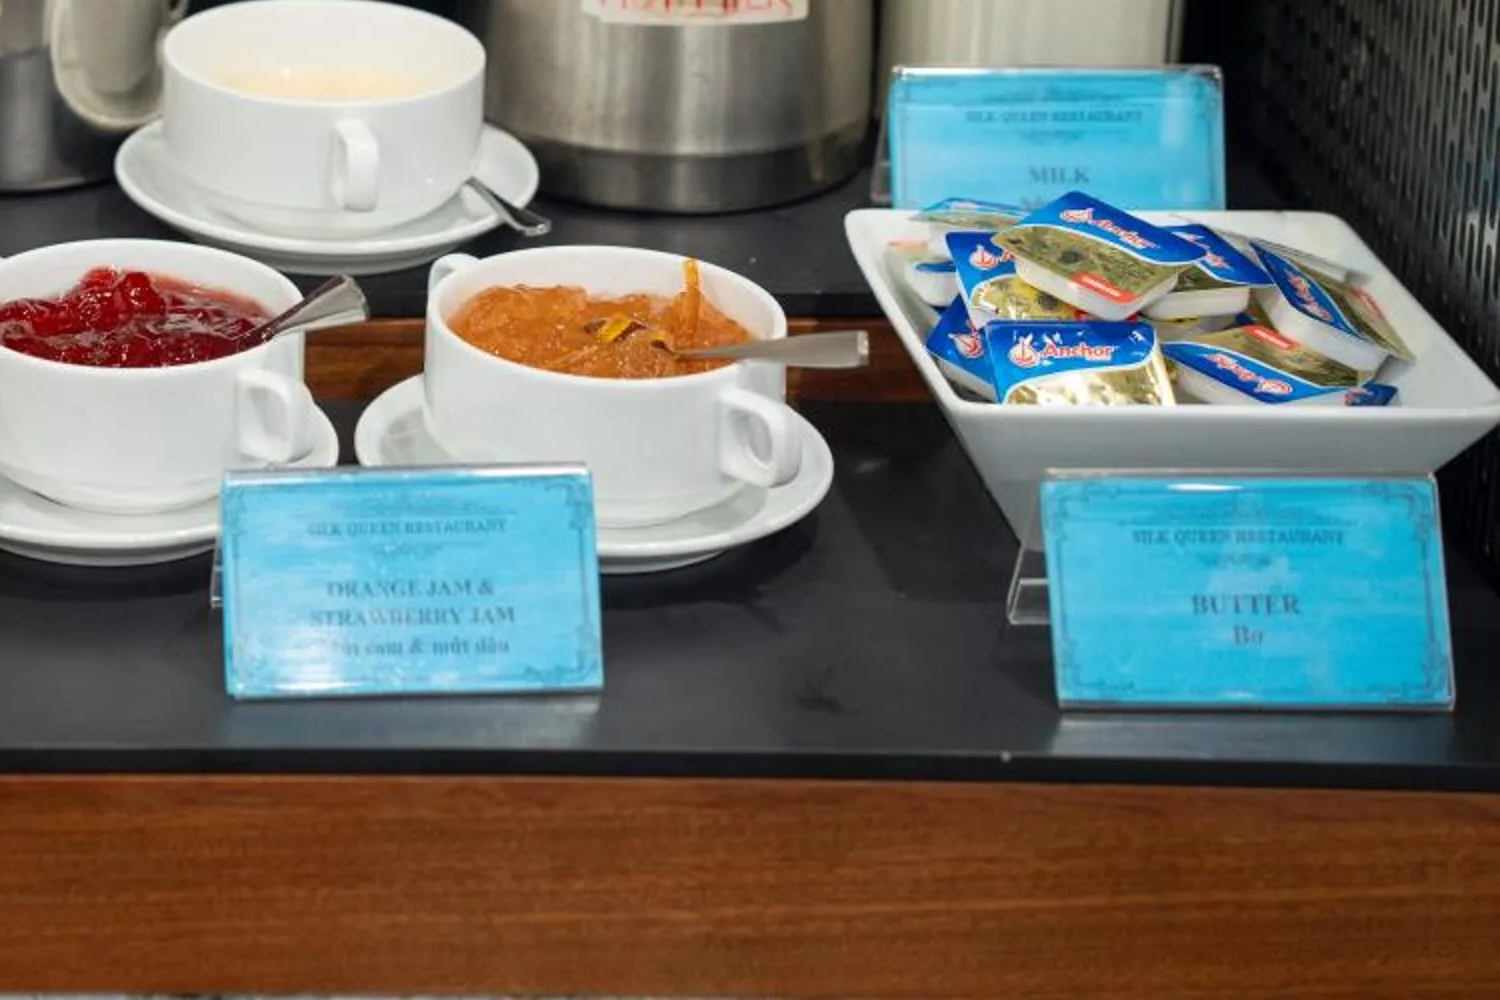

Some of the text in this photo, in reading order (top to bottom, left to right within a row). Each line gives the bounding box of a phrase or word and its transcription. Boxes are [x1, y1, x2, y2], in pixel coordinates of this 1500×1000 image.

[1029, 165, 1092, 185] MILK
[1042, 341, 1115, 358] Anchor
[327, 578, 495, 599] ORANGE JAM &
[1191, 593, 1302, 616] BUTTER
[309, 606, 515, 628] STRAWBERRY JAM
[408, 636, 424, 655] &
